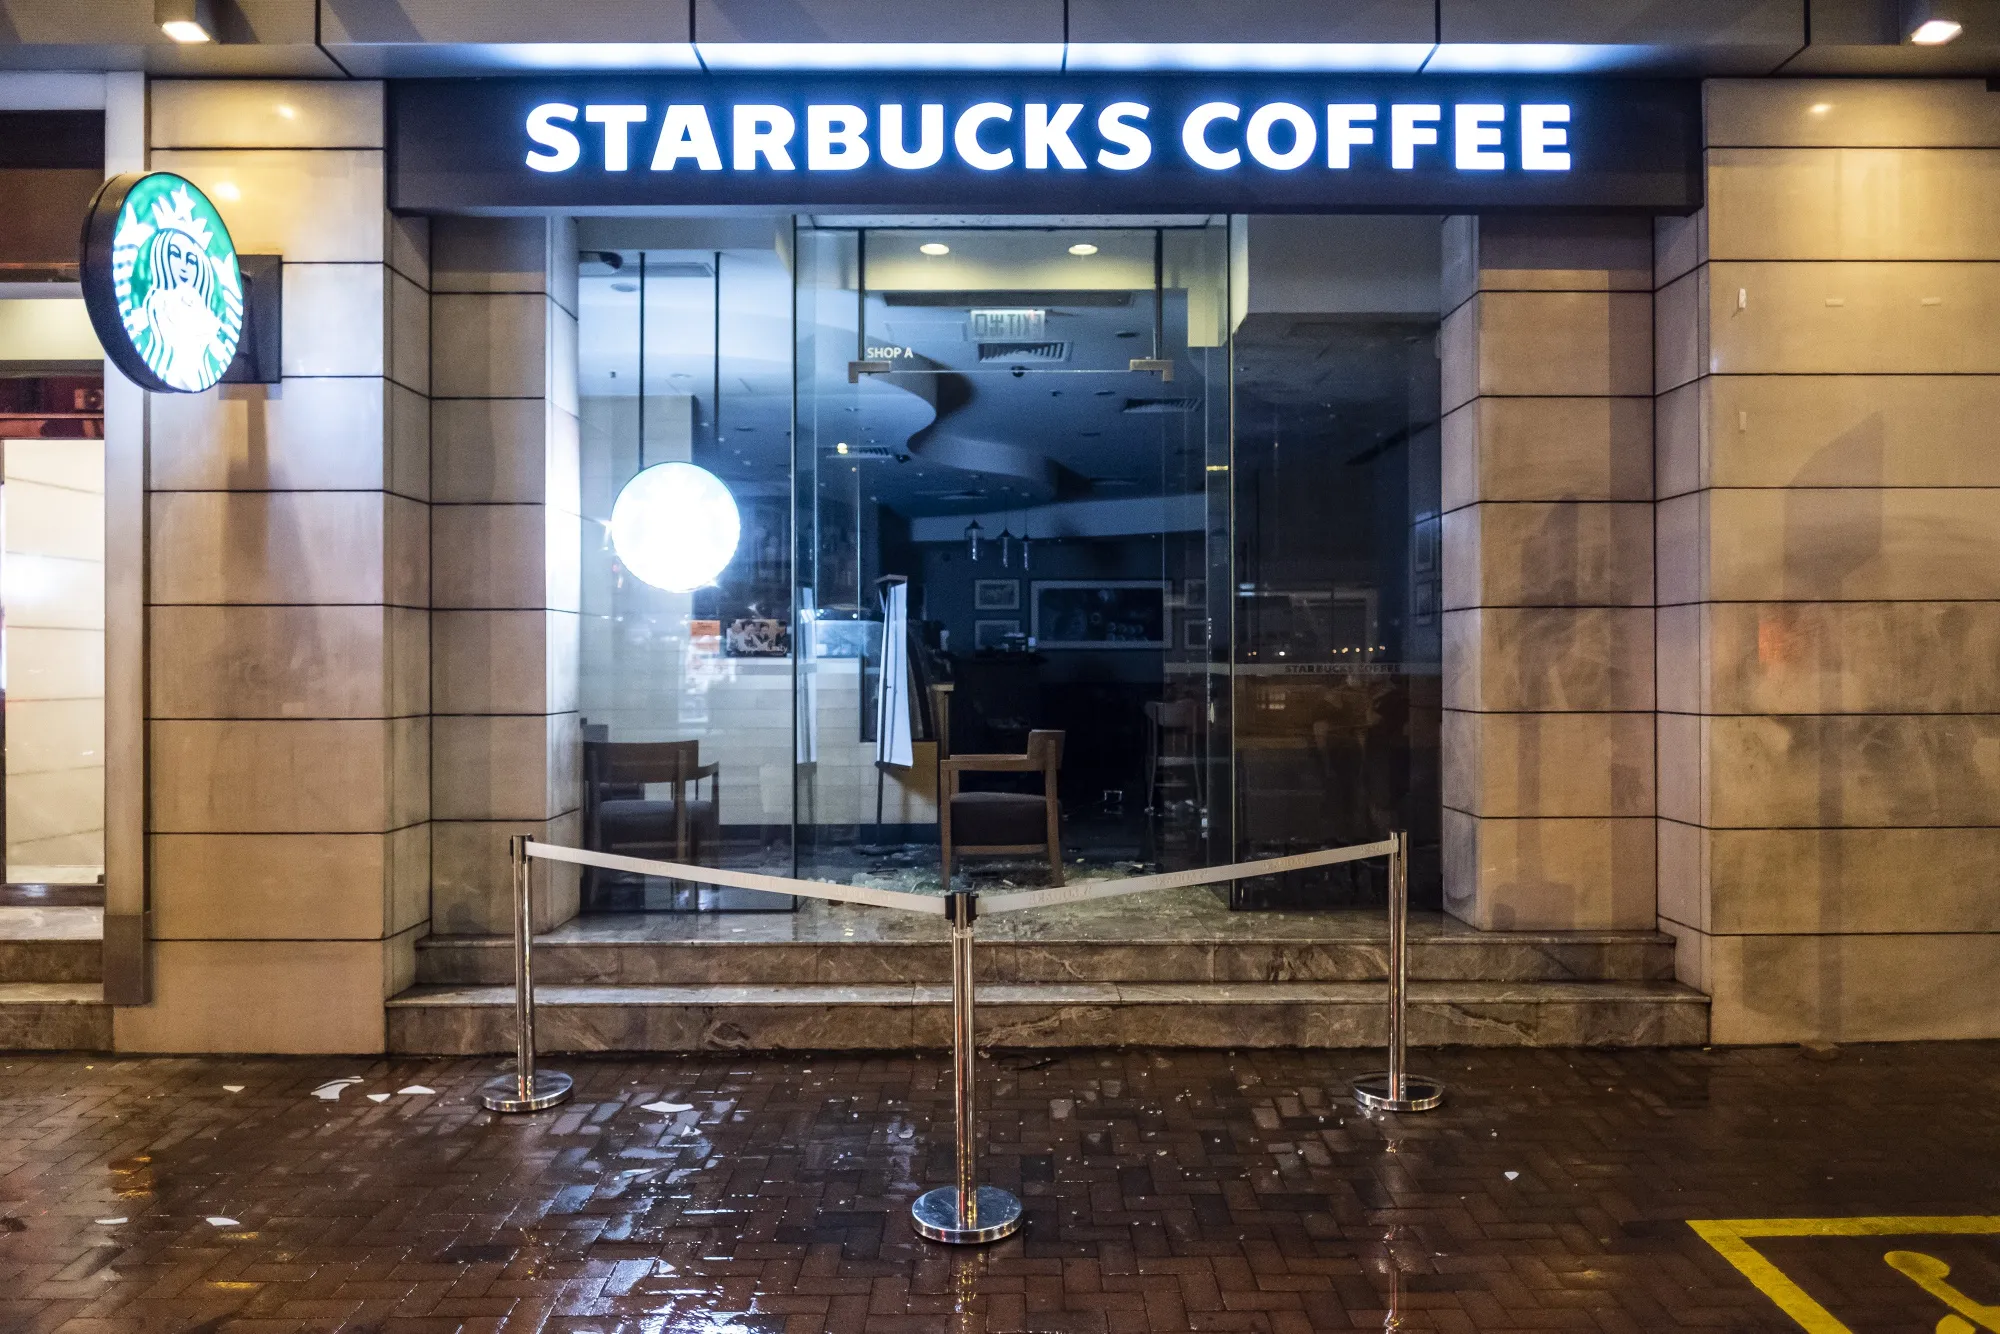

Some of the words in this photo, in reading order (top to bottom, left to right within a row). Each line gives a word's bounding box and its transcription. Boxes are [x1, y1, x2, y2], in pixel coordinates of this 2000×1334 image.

[525, 102, 1152, 173] STARBUCKS
[1182, 101, 1571, 171] COFFEE
[867, 347, 901, 359] SHOP
[904, 347, 914, 359] A
[1284, 664, 1354, 674] STARBUCKS
[1358, 664, 1401, 673] COFFEE
